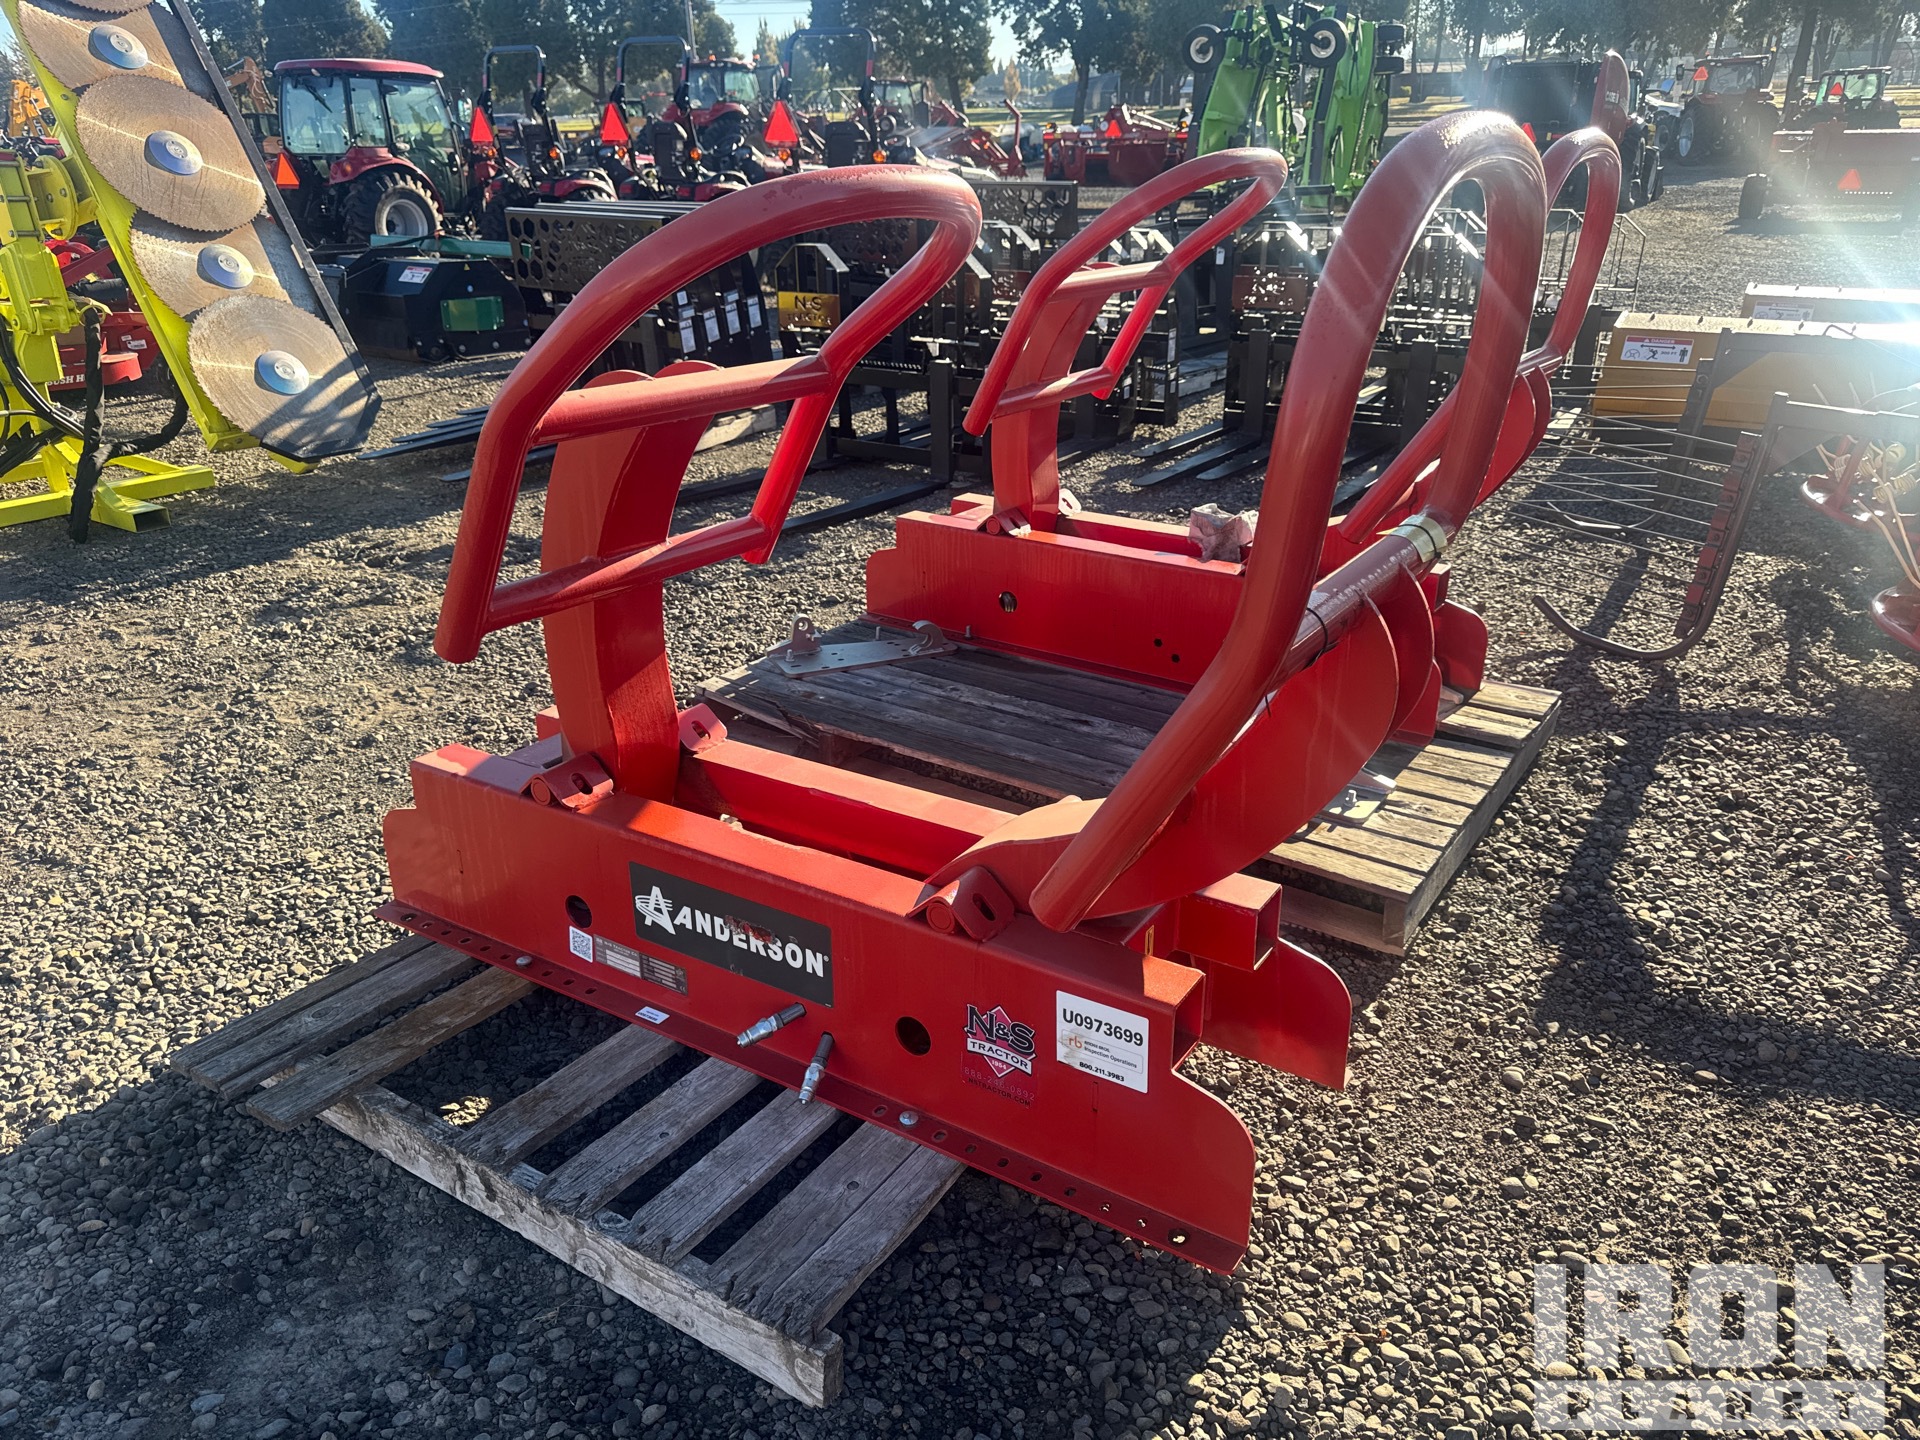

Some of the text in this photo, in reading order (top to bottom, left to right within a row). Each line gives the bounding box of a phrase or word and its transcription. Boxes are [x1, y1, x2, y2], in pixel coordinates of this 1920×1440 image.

[674, 906, 824, 977] ANDERSON
[966, 1003, 1036, 1054] N&S
[1062, 1008, 1144, 1047] U0973699
[970, 1041, 1029, 1069] TRACTOR
[991, 1059, 1007, 1070] 1954
[1084, 1046, 1138, 1069] Inspection Operations
[1079, 1061, 1125, 1082] 800.211.3983
